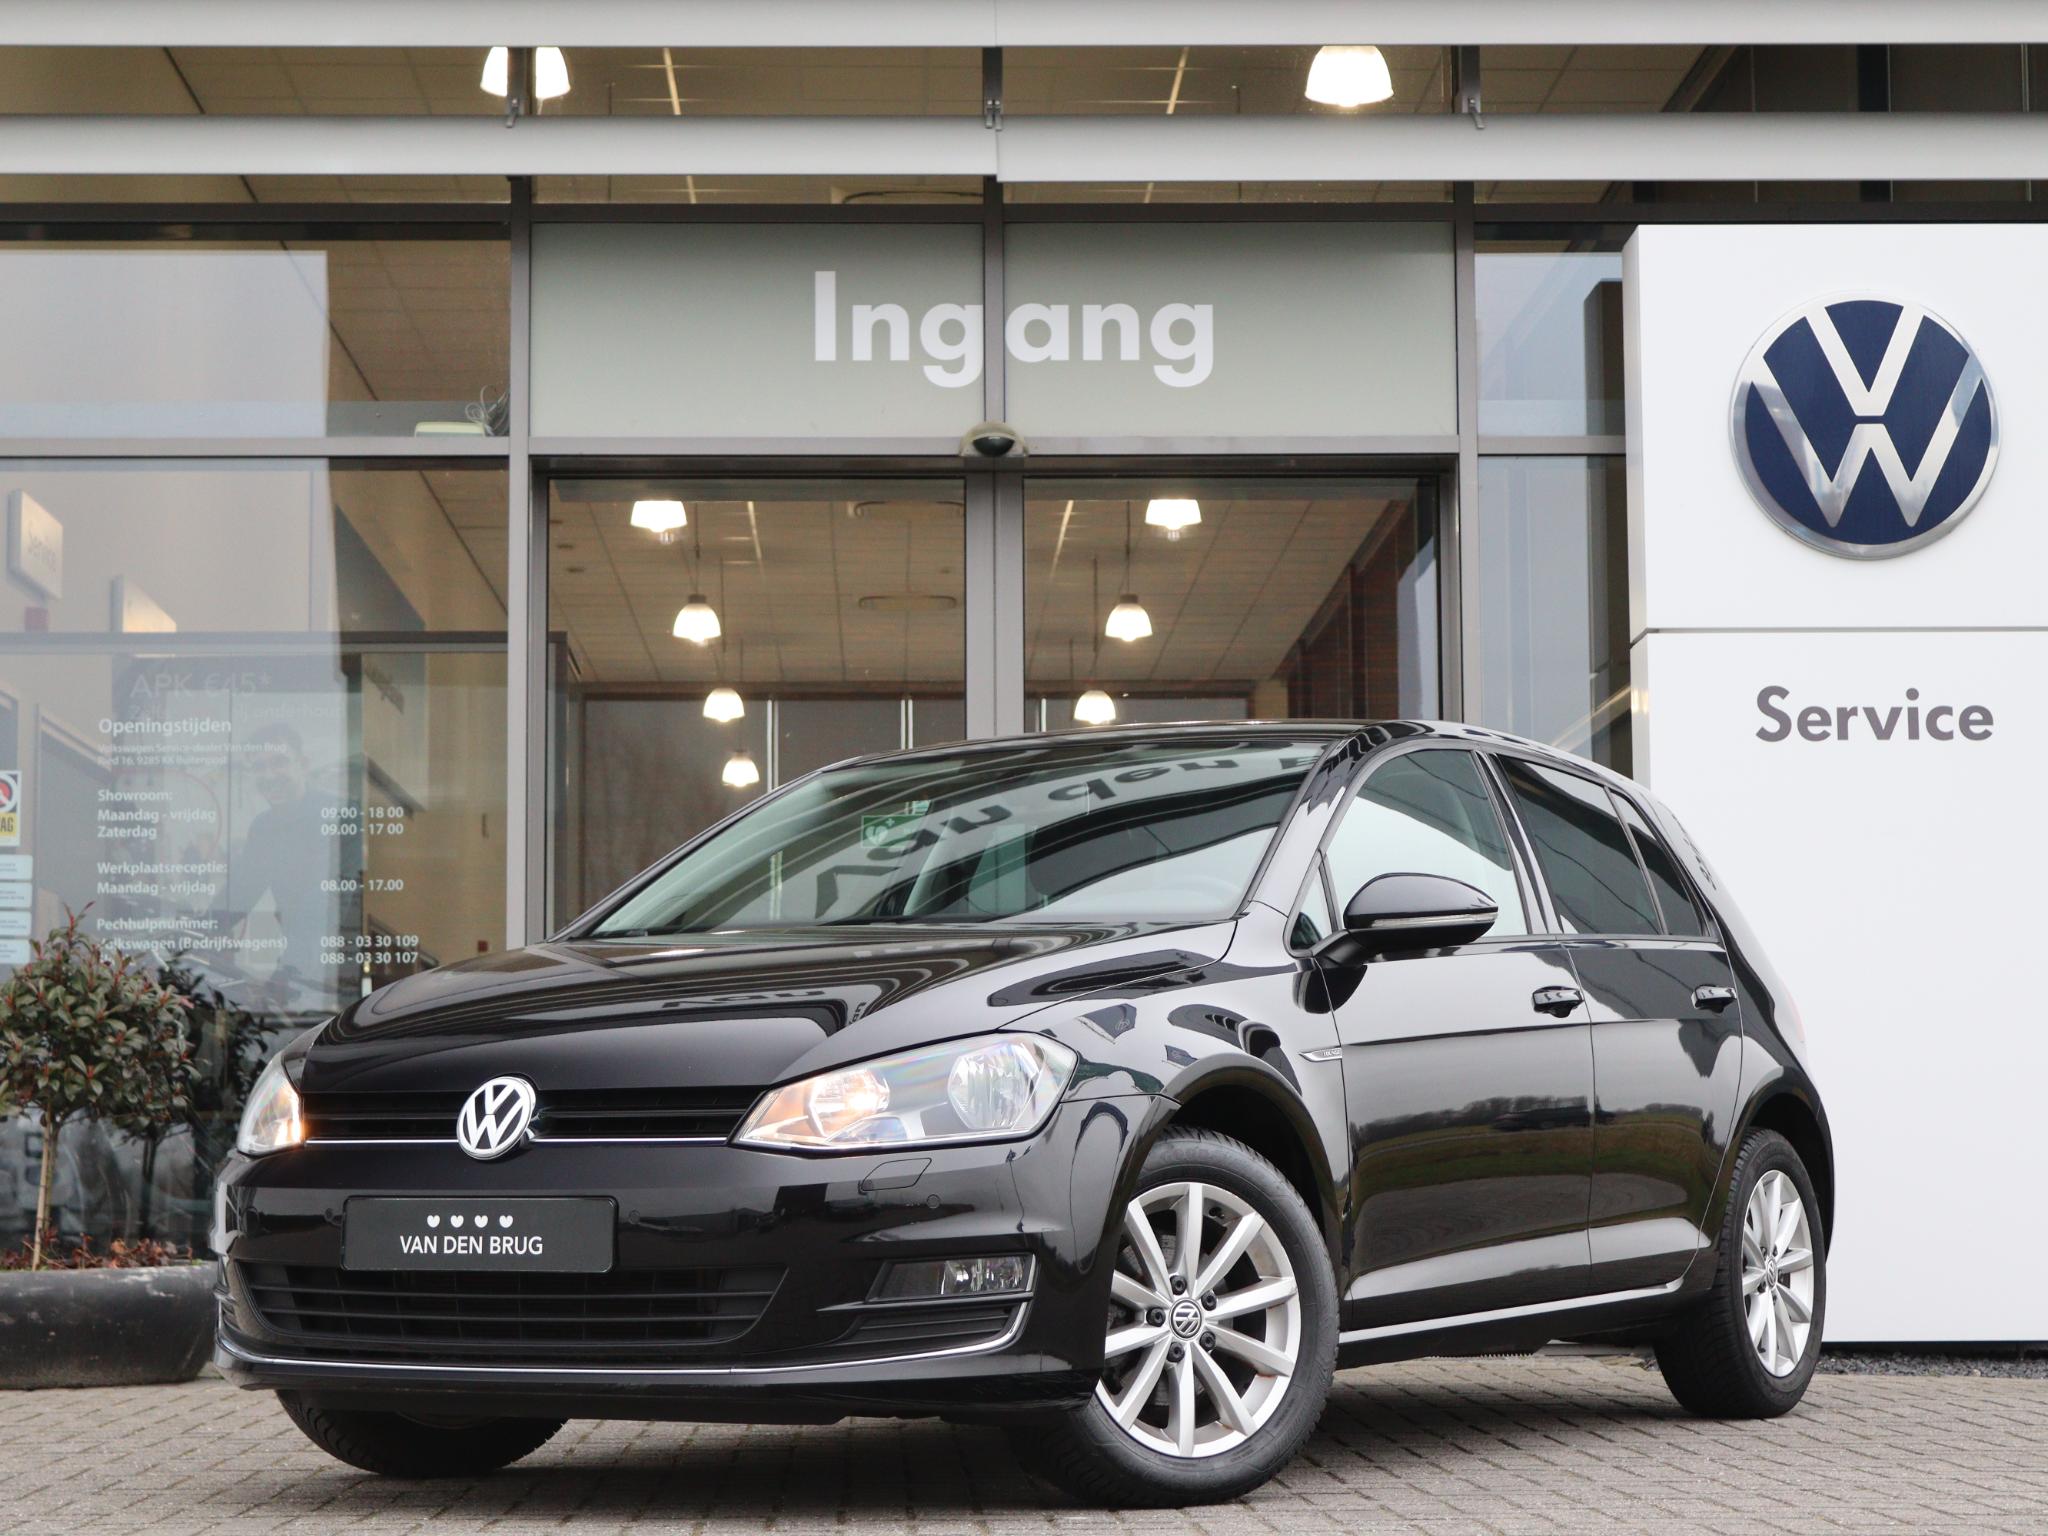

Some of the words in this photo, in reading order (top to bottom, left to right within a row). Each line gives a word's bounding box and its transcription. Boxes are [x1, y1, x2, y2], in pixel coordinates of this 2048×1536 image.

[814, 270, 1214, 388] Ingang
[1755, 685, 1994, 743] Service
[98, 717, 232, 736] Openingstijden
[98, 788, 173, 802] Showroom:
[97, 808, 160, 824] Maandag
[169, 808, 217, 824] vrijdag
[320, 807, 357, 819] 09.00
[97, 825, 157, 840] Zaterdag
[320, 823, 357, 836] 09.00
[97, 860, 228, 876] Werkplaatsreceptie:
[97, 881, 159, 896] Maandag
[169, 880, 216, 896] vrijdag
[320, 879, 357, 892] 08.00
[368, 879, 405, 892] 17.00
[96, 917, 219, 933] Pechhulpnummer:
[178, 936, 288, 952] (Bedrijfswagens)
[320, 935, 345, 948] 088
[355, 935, 372, 948] 03
[374, 935, 392, 948] 30
[395, 935, 419, 947] 109
[320, 951, 345, 964] 088
[355, 952, 372, 964] 03
[374, 952, 392, 964] 30
[395, 952, 419, 964] 107
[400, 1235, 438, 1254] VAN
[443, 1235, 483, 1255] DEN
[489, 1235, 543, 1255] BRUG
